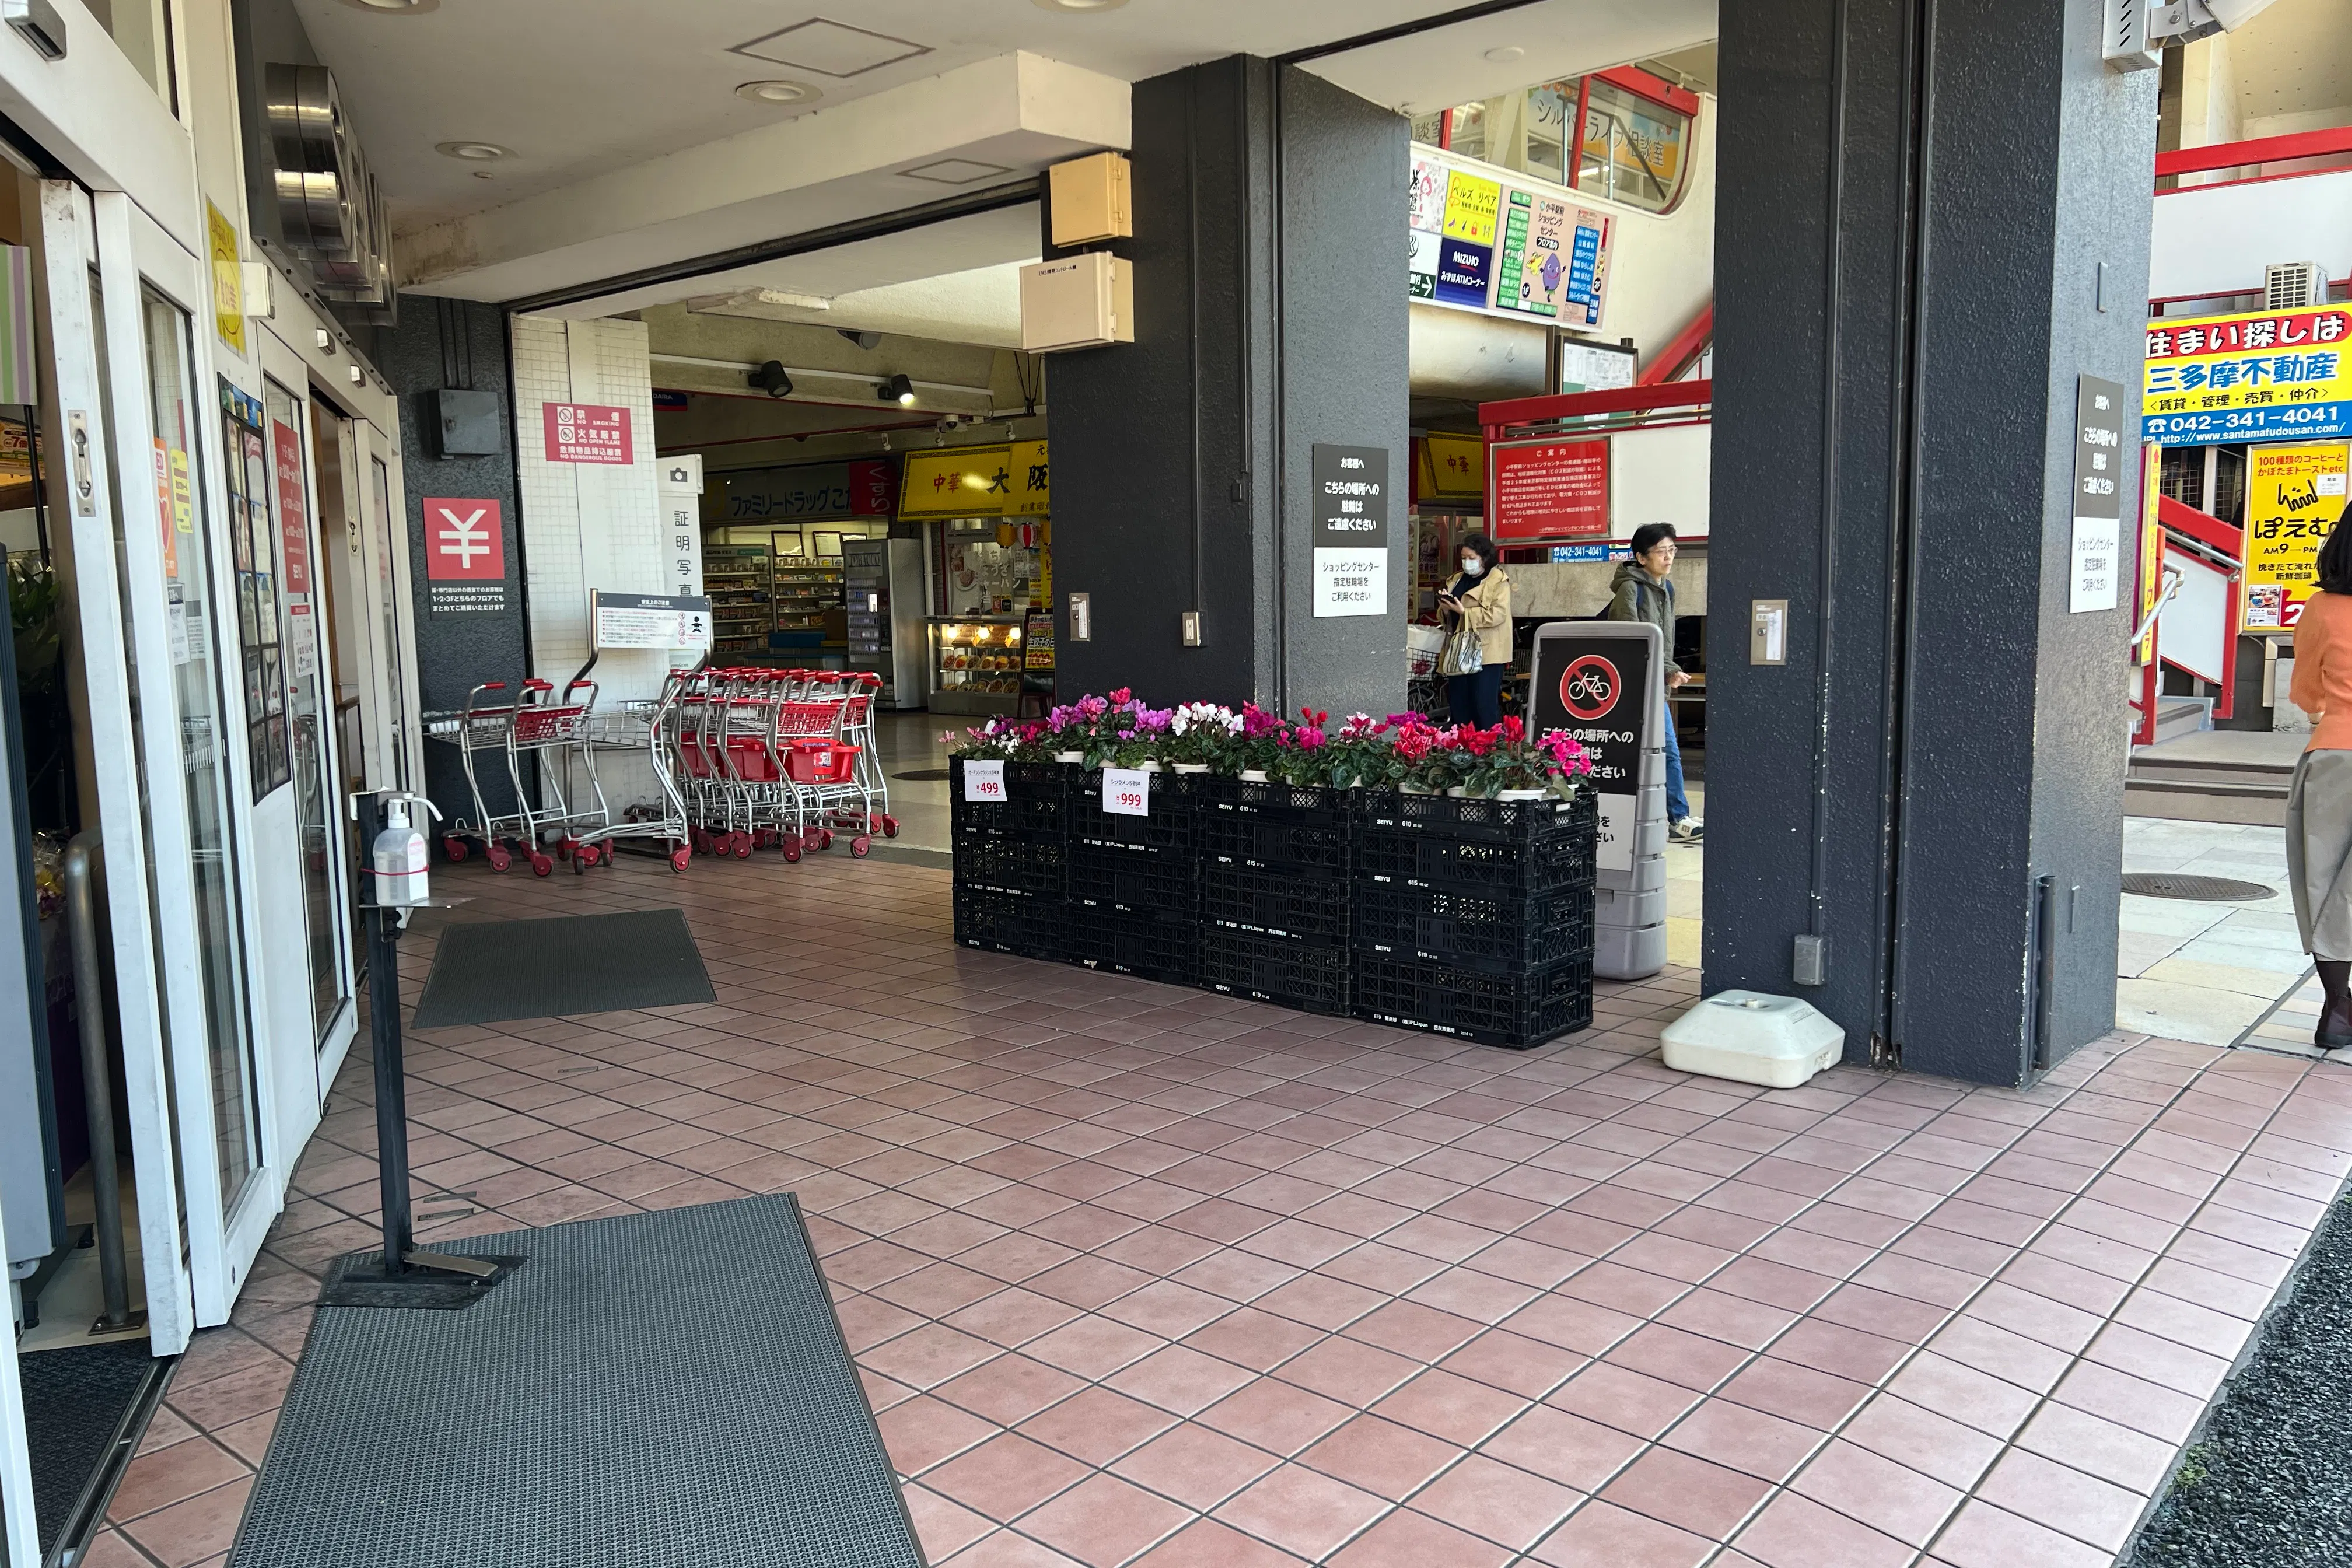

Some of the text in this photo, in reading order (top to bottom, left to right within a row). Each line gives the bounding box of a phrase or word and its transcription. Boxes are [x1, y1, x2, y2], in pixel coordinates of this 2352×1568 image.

[1538, 212, 1563, 228] ショッピング
[1540, 226, 1558, 237] センター
[1452, 251, 1479, 267] MIZUHO
[1441, 271, 1485, 288] みずほATMコーナー
[2146, 314, 2343, 359] 住まい探しは
[2147, 352, 2338, 394] 三多摩不動産
[2170, 406, 2338, 431] 042-341-4041
[2161, 422, 2346, 444] http://www.santamafudousan.com/
[1340, 457, 1364, 469] お客様へ
[2258, 453, 2344, 466] 100種類のコーヒーと
[933, 463, 1048, 494] 中華 大阪
[1324, 481, 1380, 496] こちらの場所への
[1341, 500, 1363, 513] 駐輪は
[1327, 517, 1377, 531] ご遠慮ください
[2254, 516, 2339, 539] ぽえむ
[674, 510, 692, 596] 証明写真
[850, 555, 880, 566] TOBACCO
[1322, 562, 1380, 572] ショッピングセンター
[1334, 576, 1369, 587] 指定駐輪場を
[1332, 592, 1371, 602] ご利用ください
